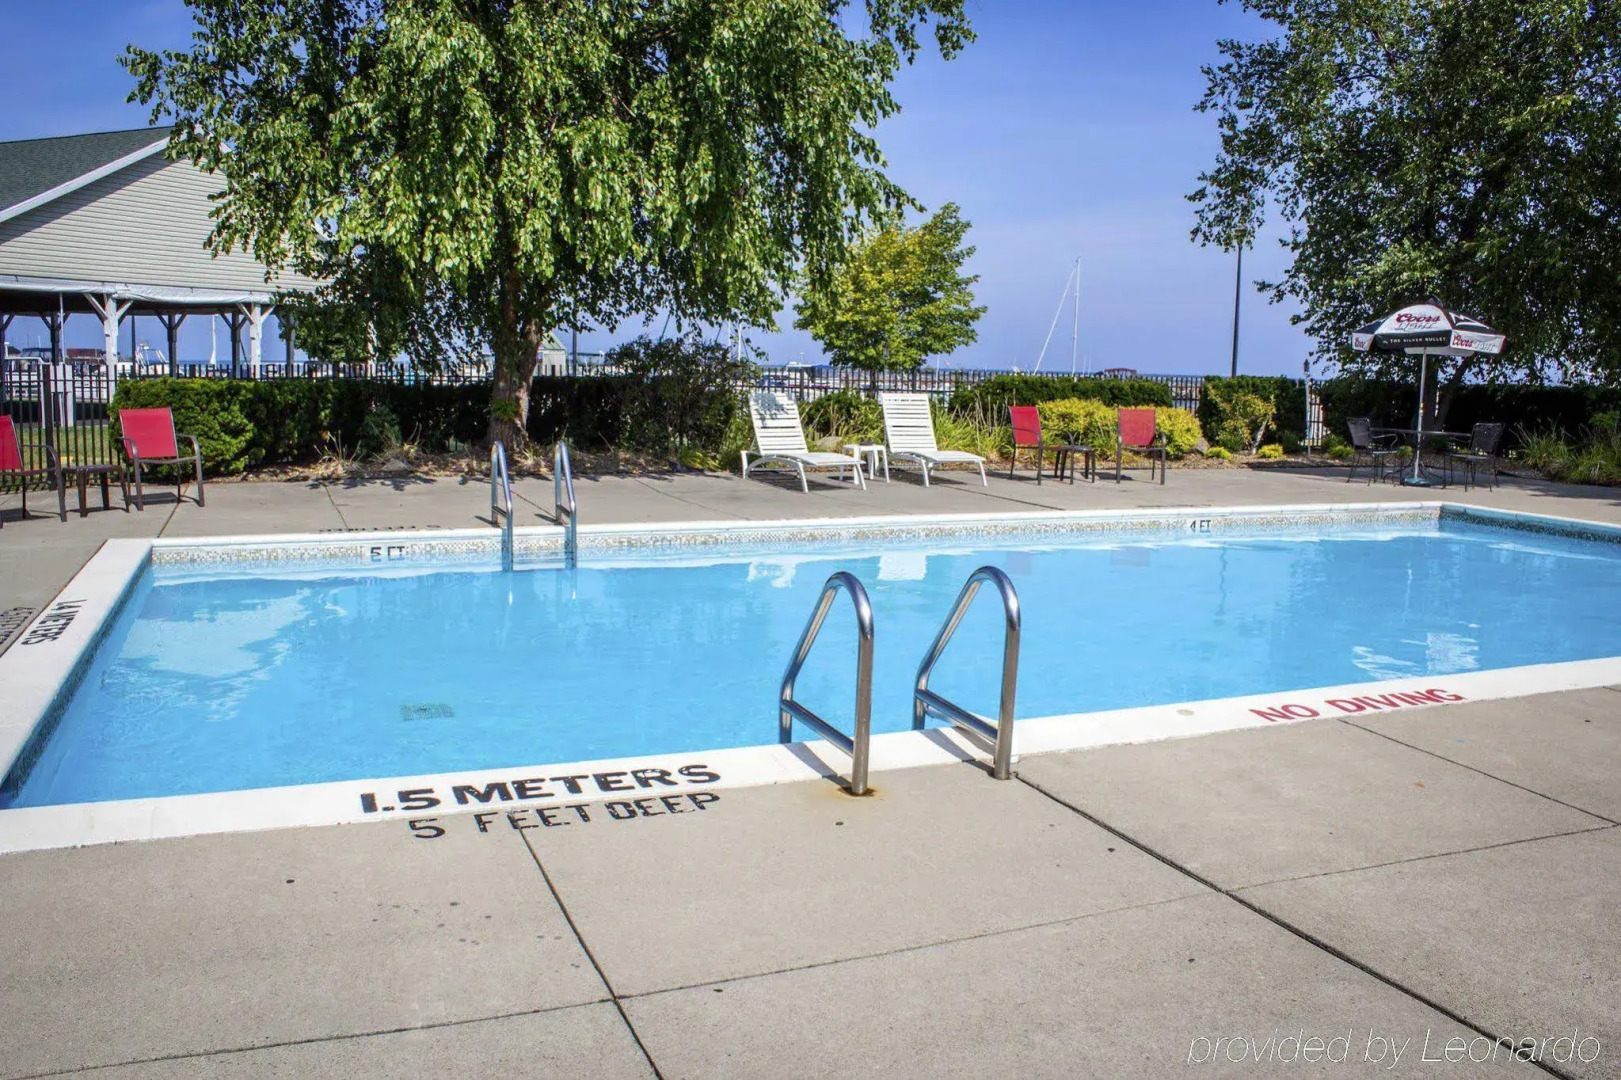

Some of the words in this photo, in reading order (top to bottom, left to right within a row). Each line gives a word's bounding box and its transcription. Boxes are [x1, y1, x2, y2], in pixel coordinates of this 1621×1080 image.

[1396, 313, 1441, 323] Coors
[1452, 334, 1473, 347] Coors
[371, 546, 381, 557] 5
[1249, 703, 1320, 722] NO
[1325, 688, 1466, 713] DIVING
[360, 787, 441, 813] 1.5
[452, 764, 721, 805] METERS
[408, 818, 446, 839] 5
[474, 803, 592, 833] FEET
[605, 792, 721, 820] DEEP
